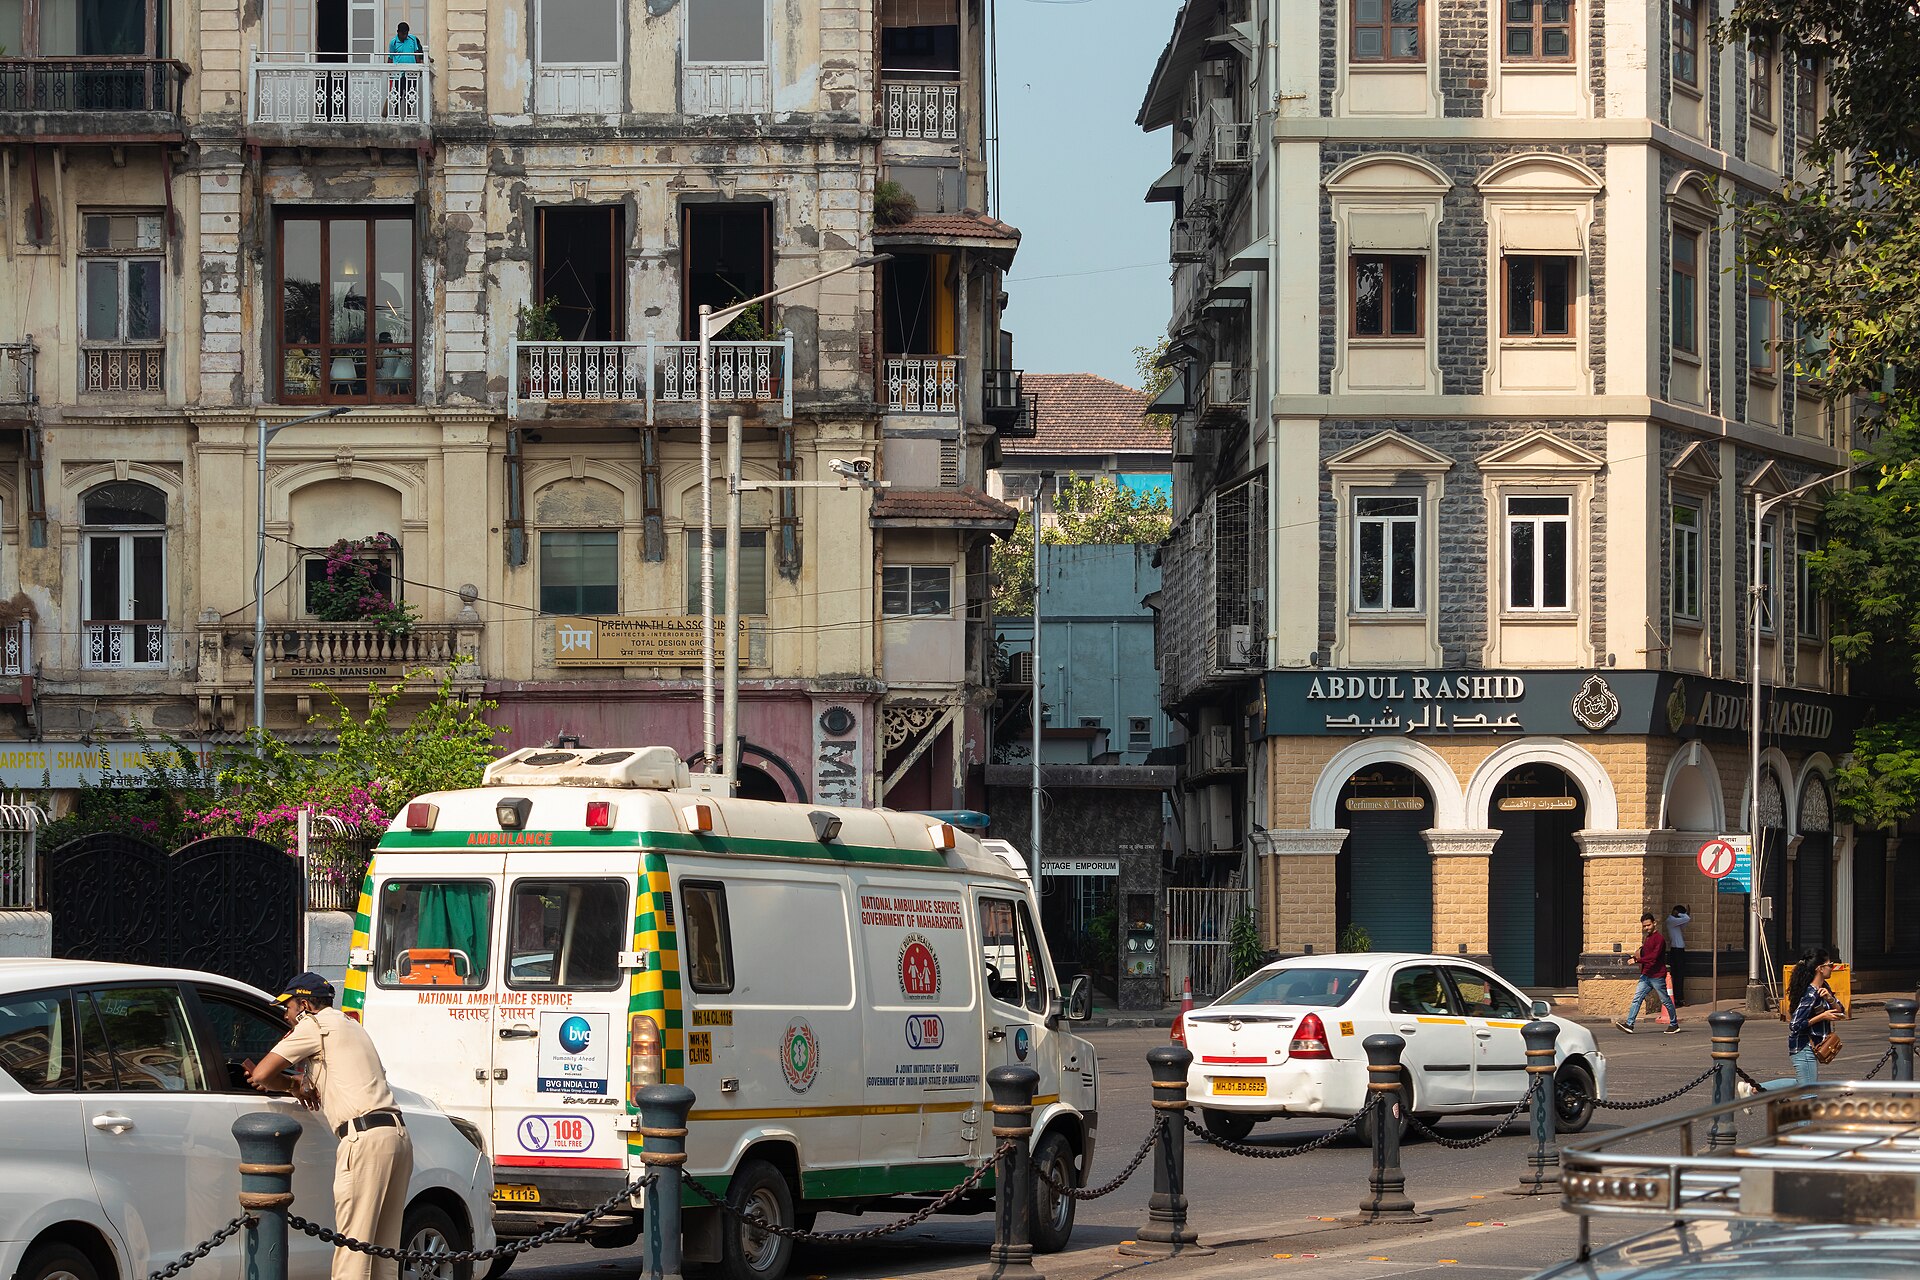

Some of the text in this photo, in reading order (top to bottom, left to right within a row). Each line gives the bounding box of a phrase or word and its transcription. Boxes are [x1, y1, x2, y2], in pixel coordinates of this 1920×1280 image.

[601, 620, 745, 630] PREM NATH & ASSOIAS
[558, 624, 594, 652] प्रेम
[340, 667, 386, 675] MANSION
[1306, 676, 1525, 699] ABDUL RASHID
[1452, 712, 1524, 733] عبد
[1696, 692, 1833, 739] ABDU RASHID
[0, 752, 46, 768] ARPETS
[1348, 800, 1422, 808] Perfumes & Textiles
[466, 832, 552, 845] AMBULANCE
[860, 896, 960, 914] NATIONAL AMBULANCE SERVICE
[862, 912, 964, 929] GOVERNMENT OF MAHARASHTRA
[898, 947, 906, 993] NATIONAL
[917, 934, 934, 953] HEALTH
[418, 992, 573, 1005] NATIONAL AMBULANCE SERVICE
[694, 1011, 732, 1024] MH 14 CL 1115
[569, 1026, 591, 1045] bvg
[922, 1019, 938, 1037] 108
[896, 1065, 899, 1073] A
[900, 1064, 912, 1073] JOINT
[913, 1064, 935, 1073] INITIATIVE
[936, 1064, 942, 1072] OF
[866, 1076, 898, 1087] (GOVERNMENT
[899, 1077, 905, 1086] OF
[906, 1076, 918, 1085] INDIA
[919, 1076, 927, 1085] AND
[928, 1076, 941, 1085] STATE
[942, 1076, 948, 1084] OF
[553, 1120, 583, 1140] 108
[492, 1190, 535, 1199] CL 1115
